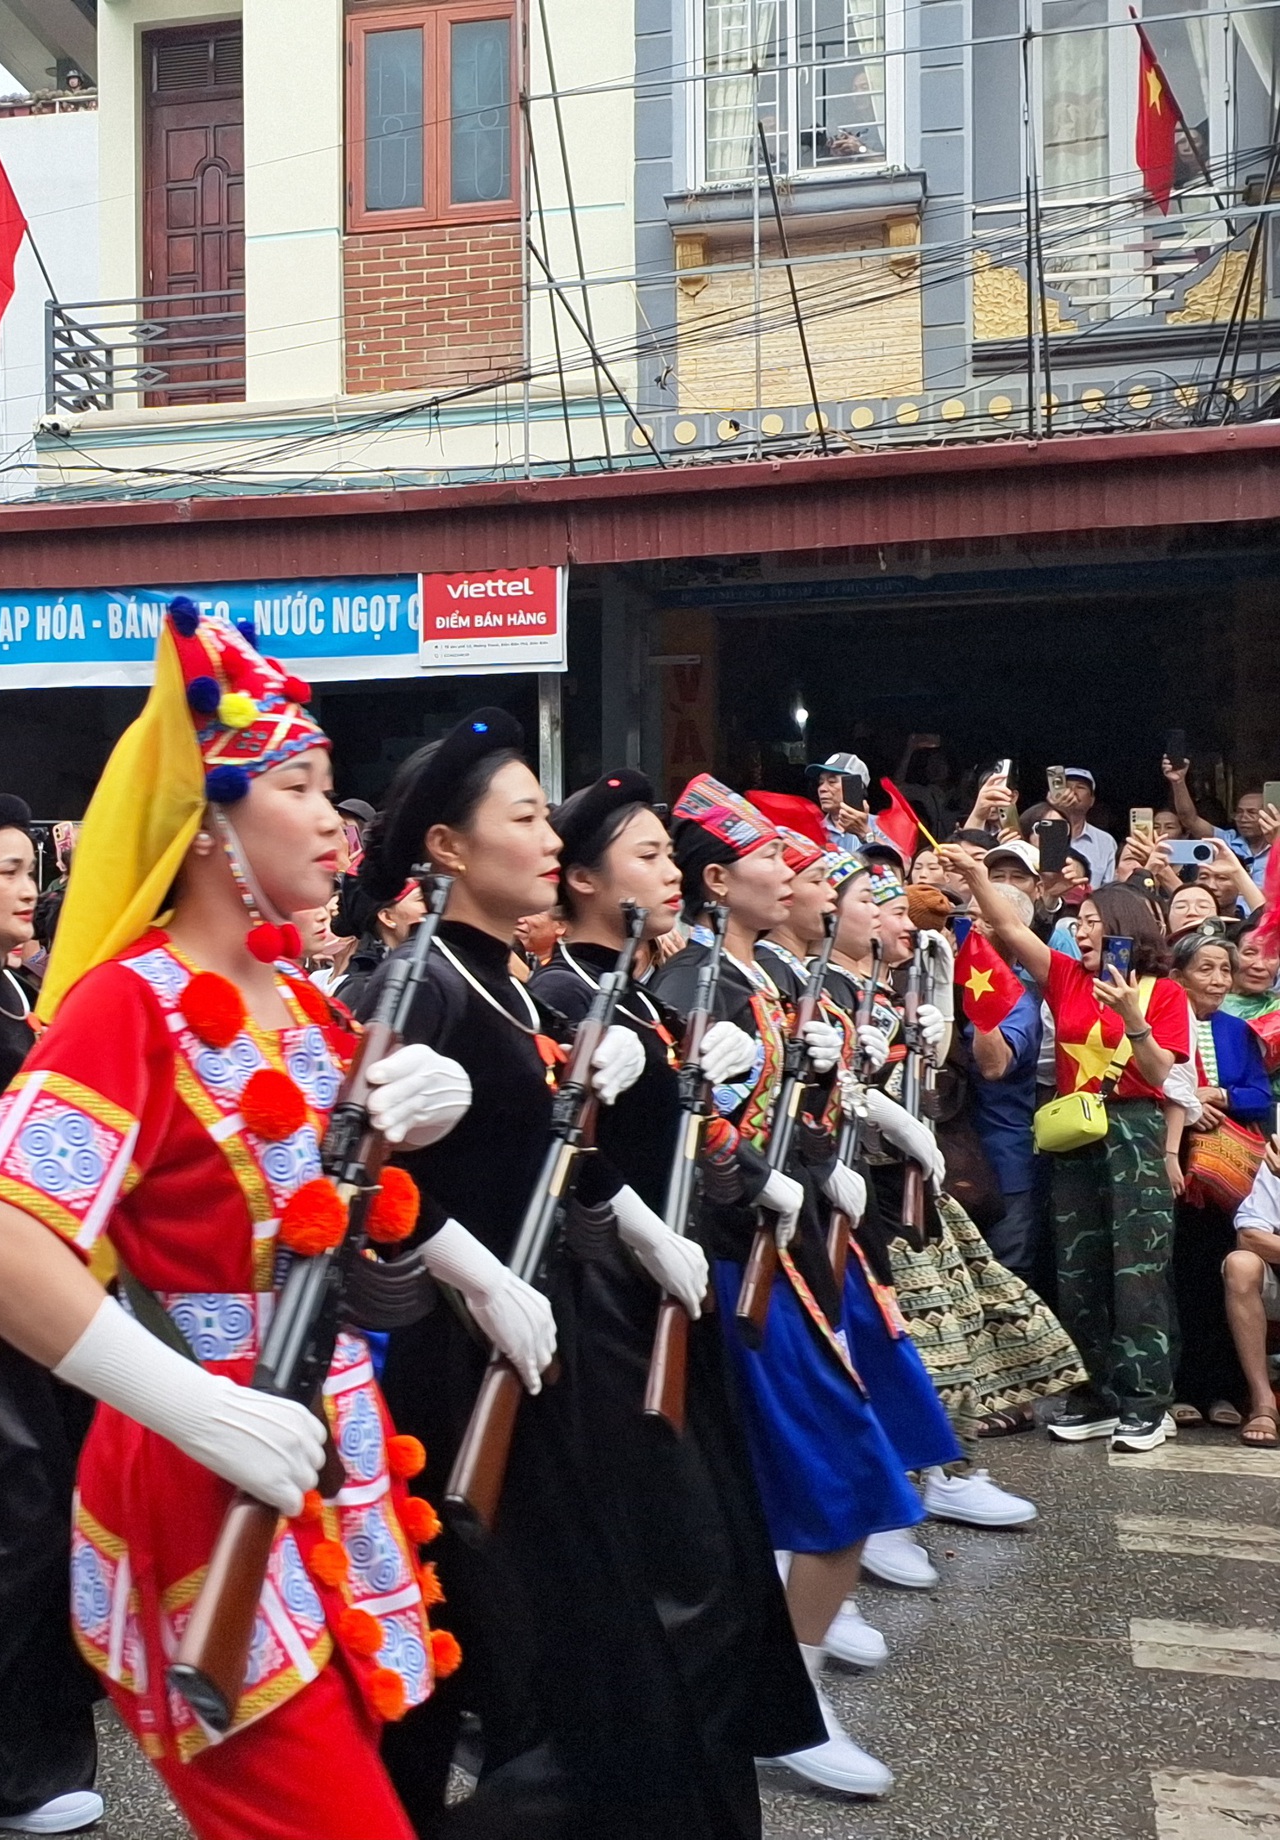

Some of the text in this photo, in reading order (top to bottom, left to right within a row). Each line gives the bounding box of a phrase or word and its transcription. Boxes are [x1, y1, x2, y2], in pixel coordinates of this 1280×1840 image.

[446, 577, 534, 599] viettel
[35, 597, 86, 641] HÓA
[253, 590, 325, 636] NƯỚC
[332, 594, 401, 641] NGỌT
[435, 609, 547, 629] ĐIỂM BÁN HÀNG
